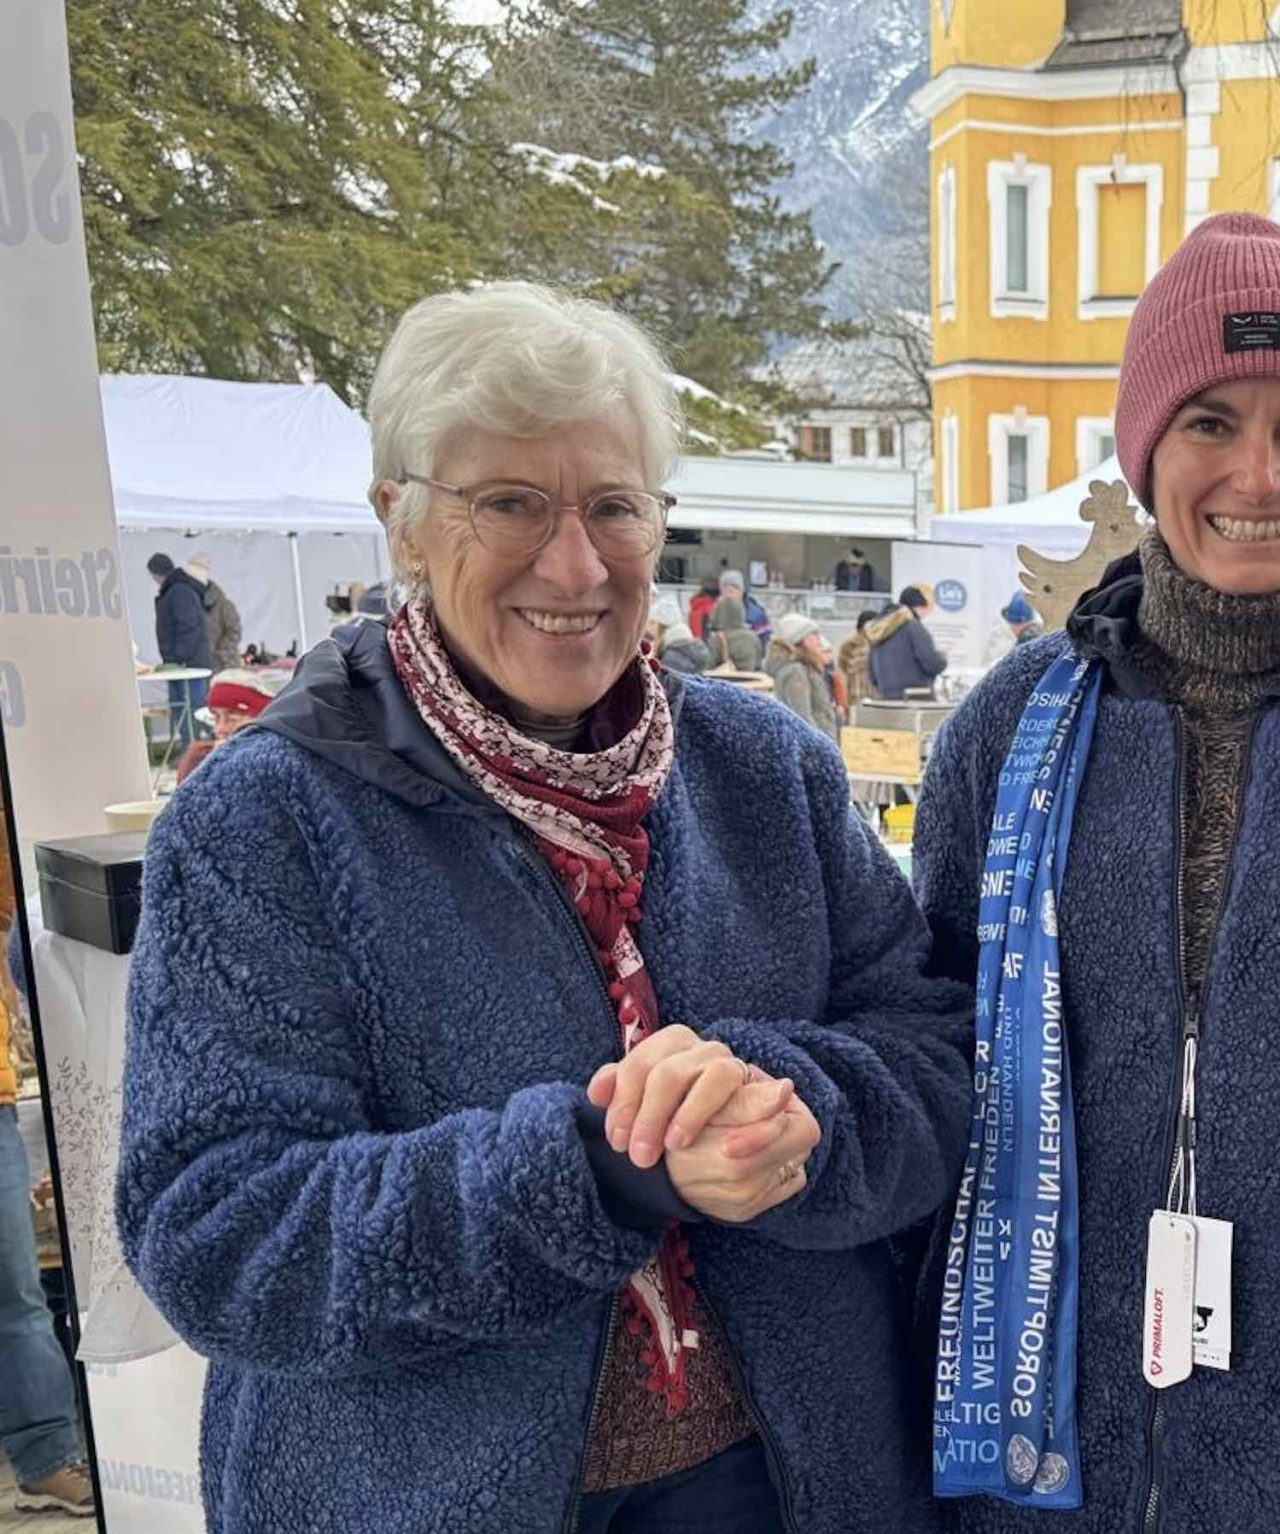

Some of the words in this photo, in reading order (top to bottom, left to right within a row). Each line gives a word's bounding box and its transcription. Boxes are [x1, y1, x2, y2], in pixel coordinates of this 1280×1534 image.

[980, 1066, 1001, 1191] FRIEDEN
[971, 1199, 997, 1390] WELTWEITER
[1151, 1288, 1165, 1358] PRIMALOFT
